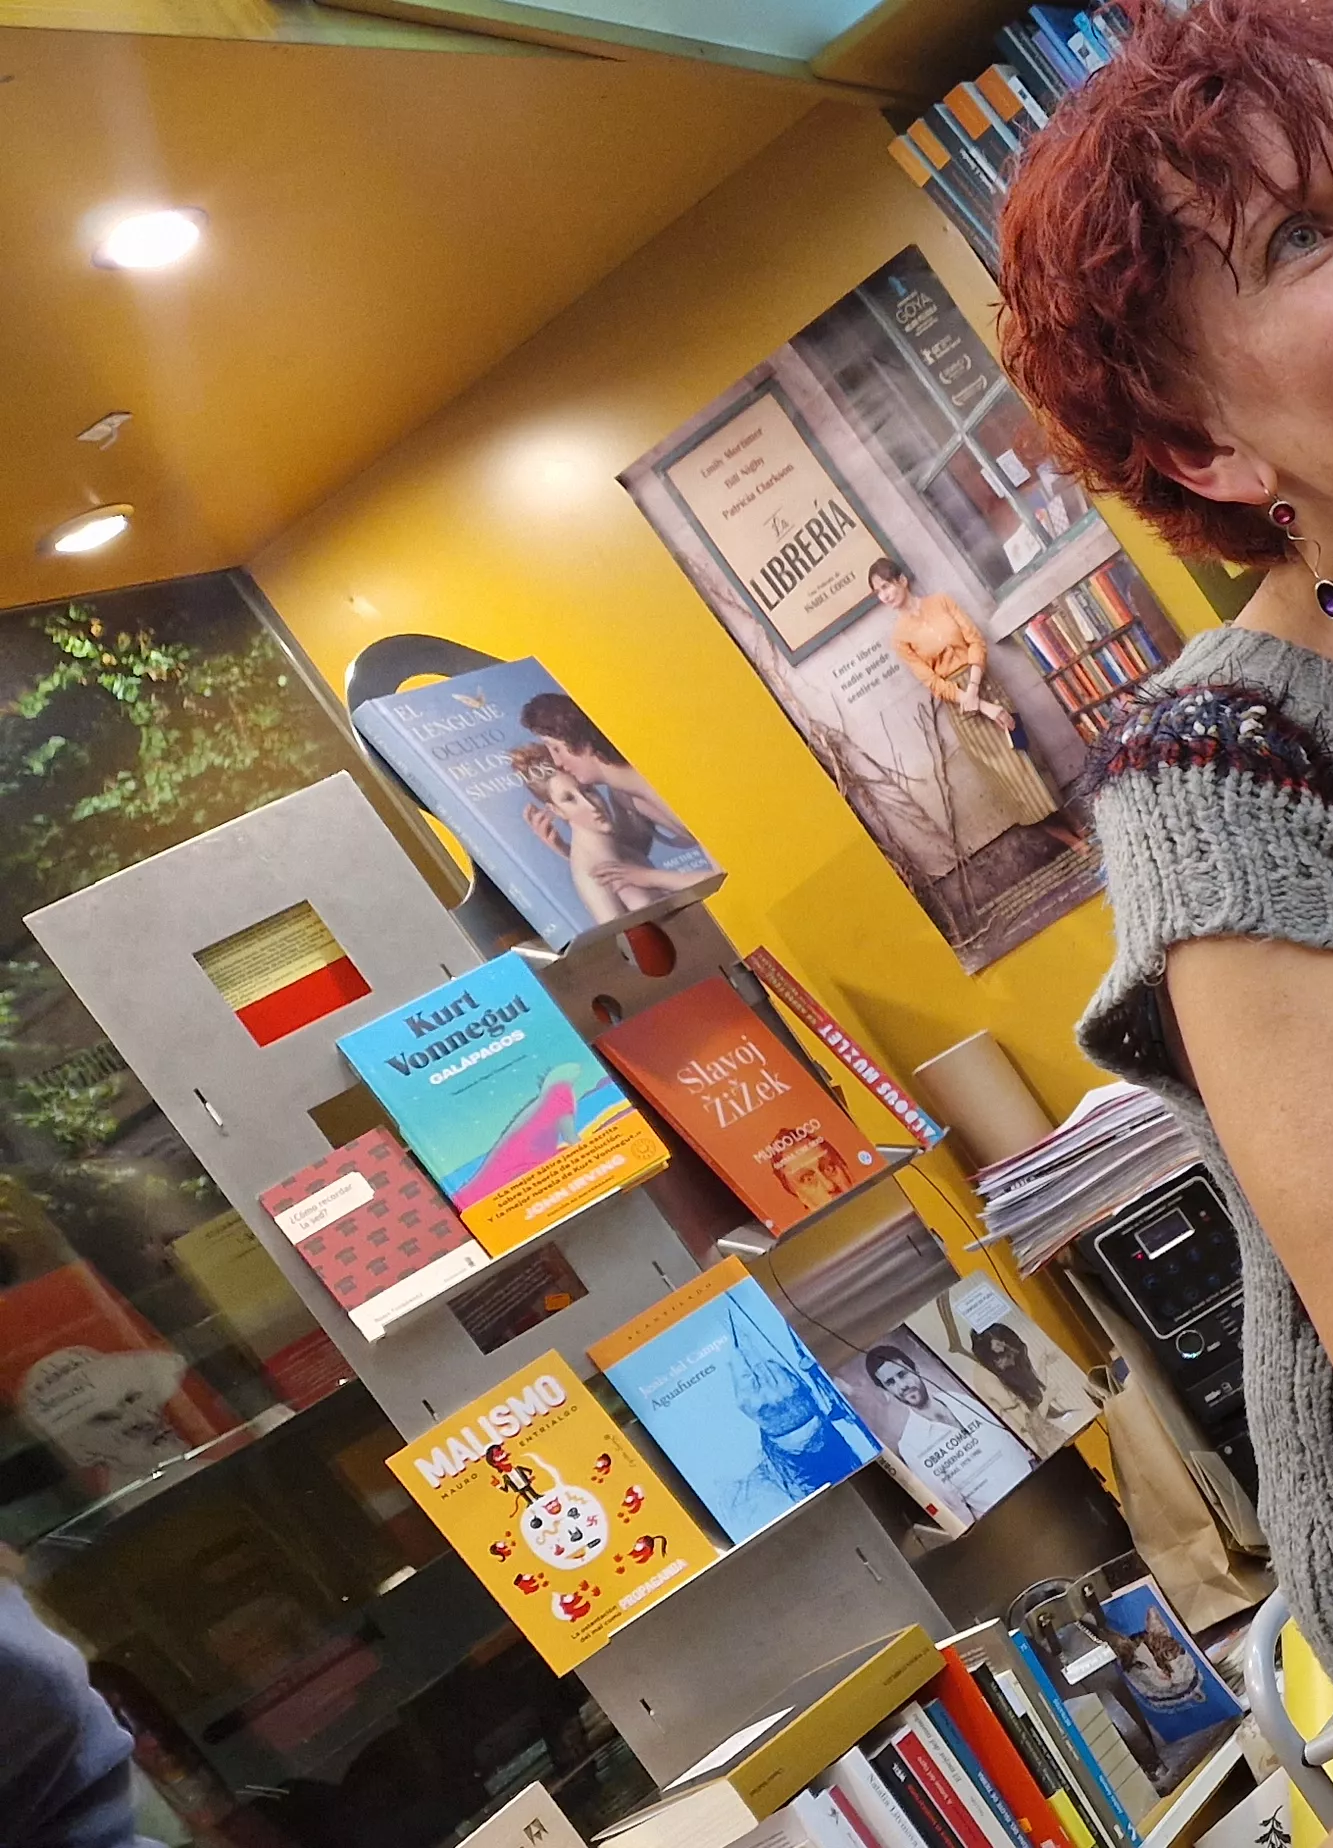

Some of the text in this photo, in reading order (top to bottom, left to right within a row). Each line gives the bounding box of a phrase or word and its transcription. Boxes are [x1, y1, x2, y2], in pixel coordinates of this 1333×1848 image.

[721, 463, 795, 520] Patricia Clarkson
[749, 498, 857, 612] LIBRERÍA
[832, 640, 882, 679] Entre libros
[841, 653, 890, 691] nadie puede
[847, 663, 900, 704] sentirse solo
[394, 704, 424, 726] EL
[412, 702, 505, 743] LENGUAJE
[431, 728, 505, 762] OCULTO
[447, 750, 514, 782] DE LOS
[465, 761, 557, 801] SÍMBOLOS
[385, 994, 530, 1076] Vonnegut
[403, 989, 480, 1039] Kurt
[429, 1029, 526, 1085] GALÁPAGOS
[676, 1034, 767, 1096] Slavoj
[874, 1078, 936, 1144] ALDOUS
[751, 1131, 795, 1166] MUNDO
[789, 1115, 822, 1143] LOCO
[289, 1182, 353, 1226] ¿Cómo recordar
[523, 1188, 570, 1220] JOHN
[566, 1151, 628, 1193] IRVING
[687, 1335, 729, 1368] Campo
[651, 1363, 717, 1412] Aguafuertes
[414, 1374, 567, 1489] MALISMO
[440, 1404, 579, 1500] MAURO ENTRIALGO
[921, 1445, 948, 1469] OBRA
[943, 1417, 984, 1452] COMPLETA
[931, 1448, 966, 1478] CUADERNO
[961, 1436, 980, 1452] ROJO
[616, 1556, 689, 1611] PROPAGANDA
[865, 1773, 893, 1807] Natalia
